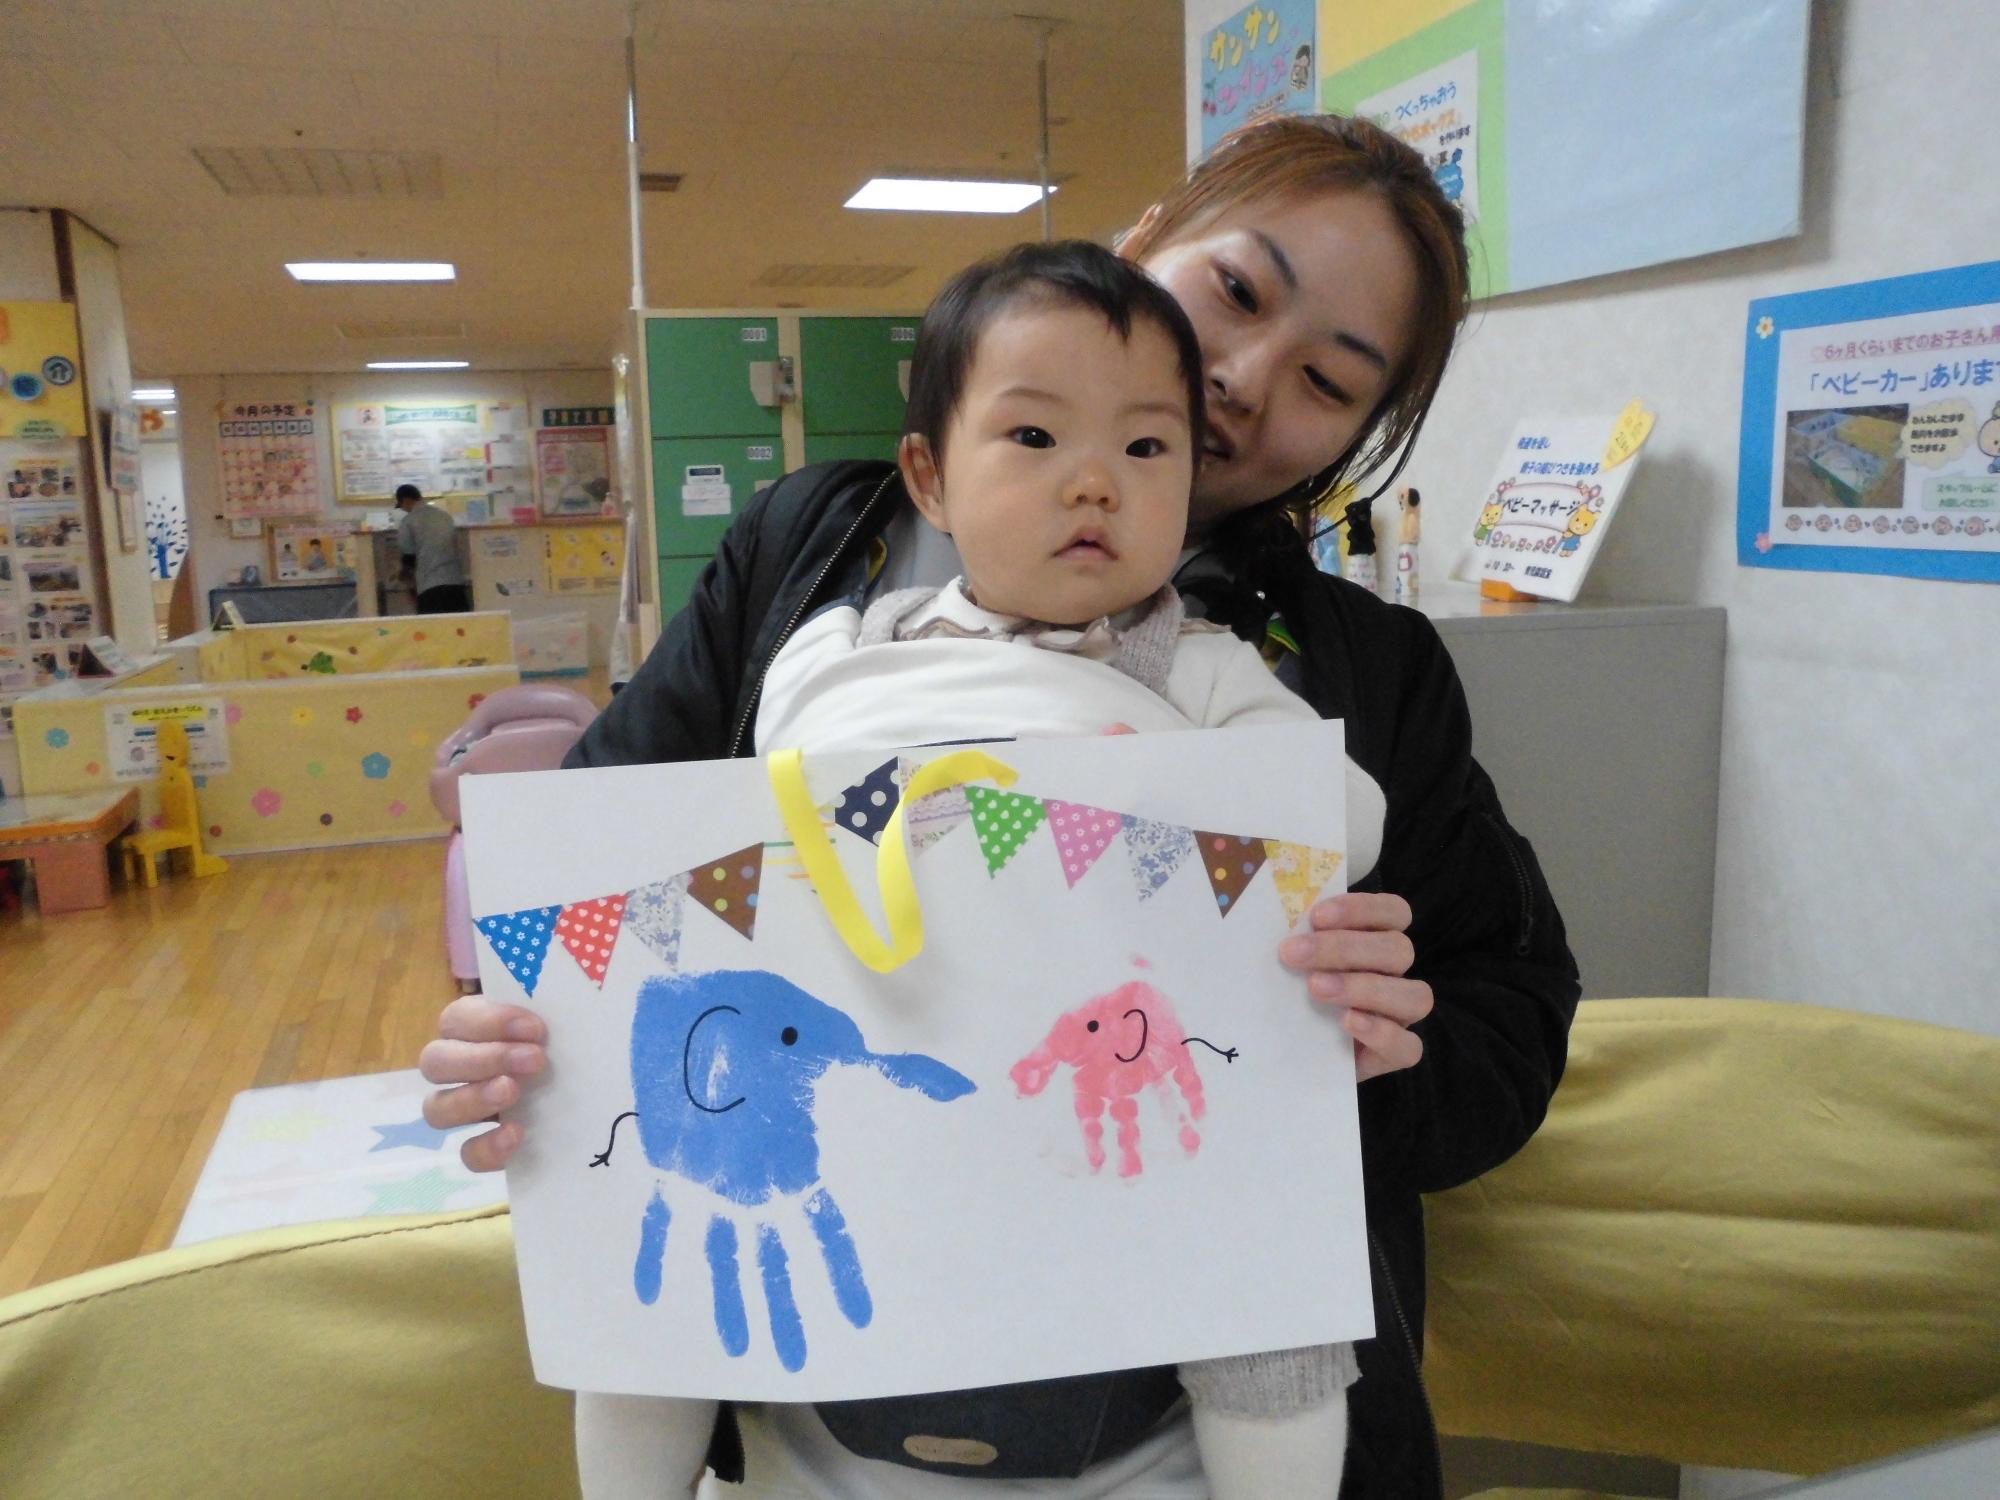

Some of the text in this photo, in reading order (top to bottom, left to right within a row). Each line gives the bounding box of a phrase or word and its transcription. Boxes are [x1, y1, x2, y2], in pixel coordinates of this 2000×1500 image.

[1810, 358, 2000, 395] 「ベビーカー」ありま
[1502, 497, 1581, 516] ベビーマッサージ
